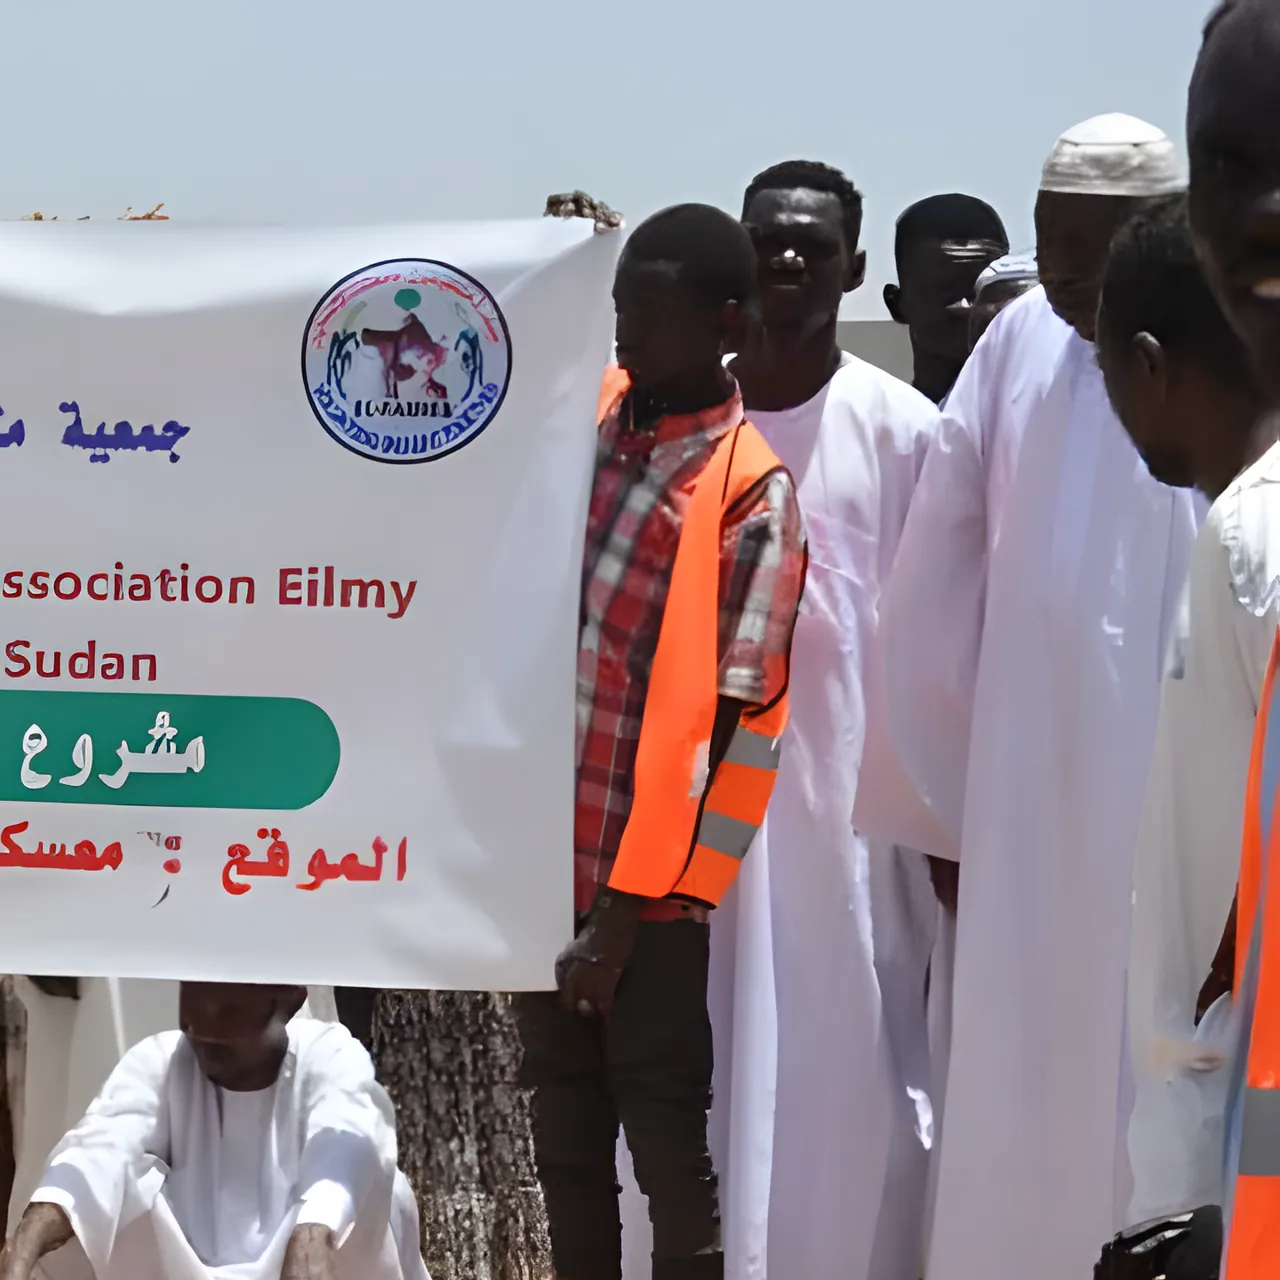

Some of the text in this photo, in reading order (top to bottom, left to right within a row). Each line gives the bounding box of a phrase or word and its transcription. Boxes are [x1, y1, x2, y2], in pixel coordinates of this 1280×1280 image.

[59, 401, 191, 464] جمعية
[278, 565, 418, 619] Eilmy
[20, 711, 206, 789] مشروع
[221, 827, 408, 896] الموقع
